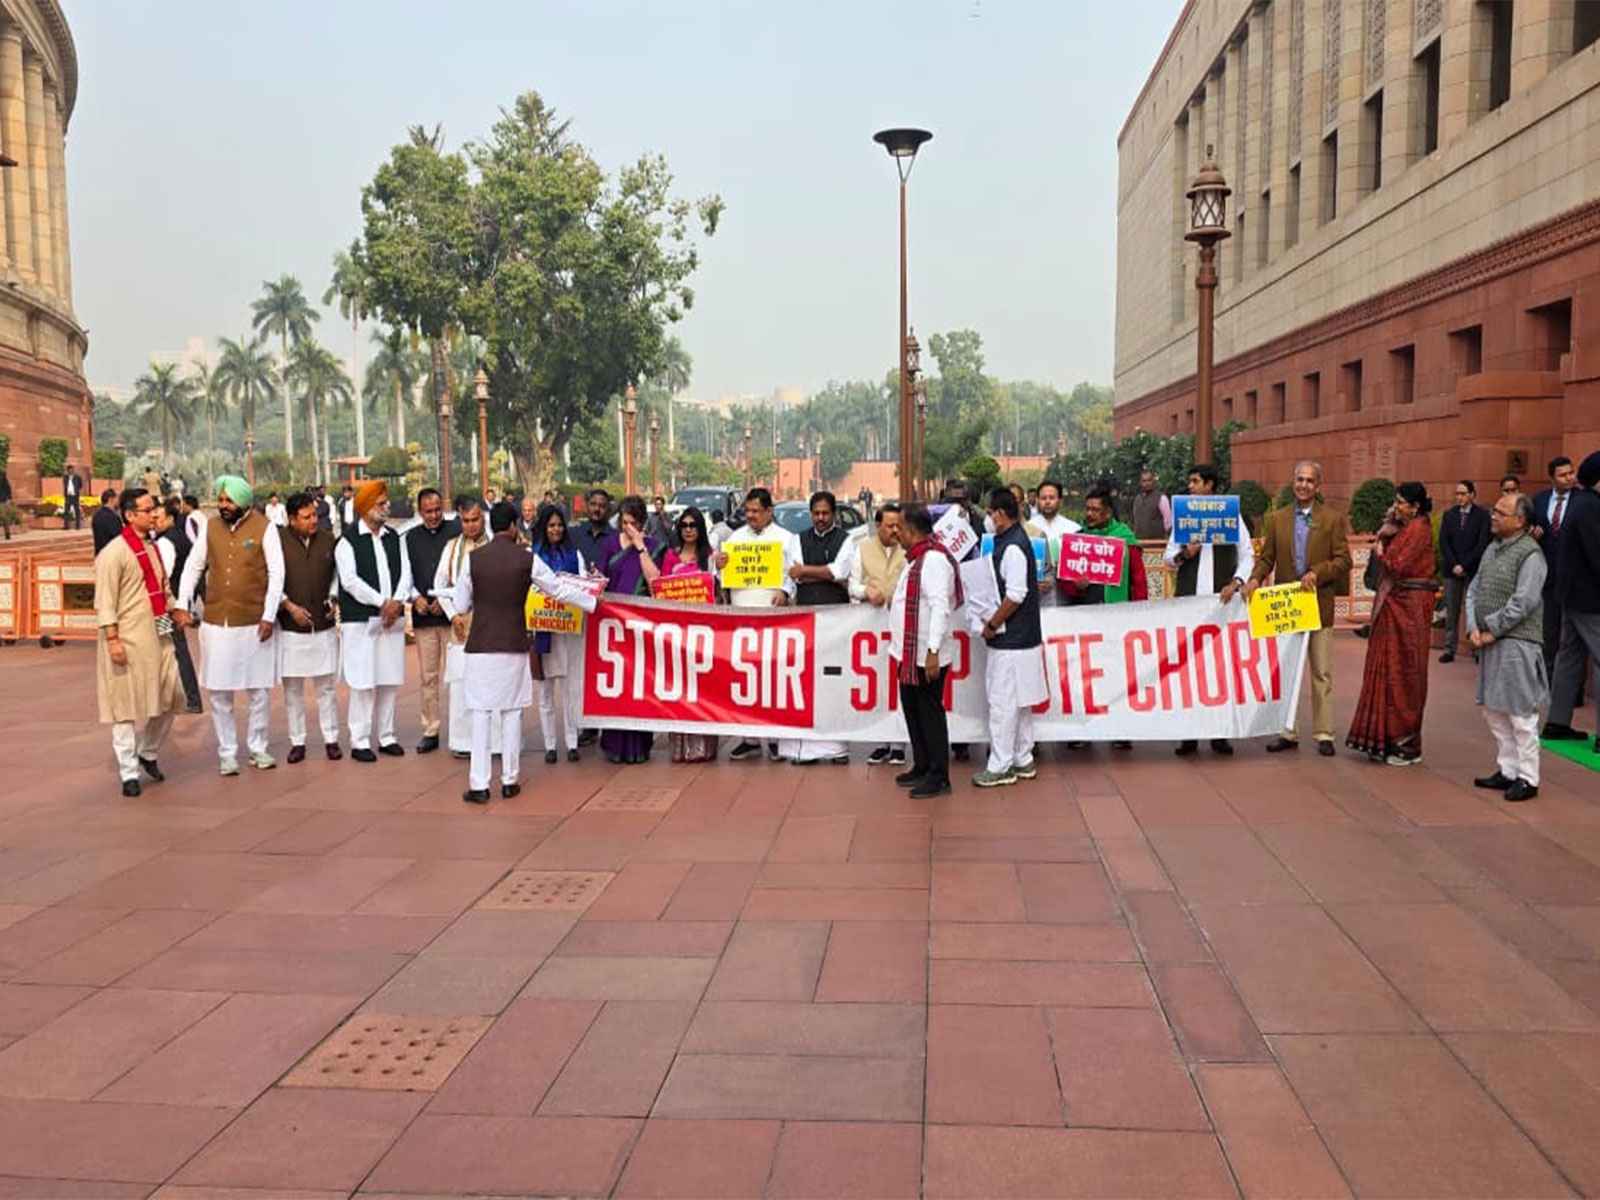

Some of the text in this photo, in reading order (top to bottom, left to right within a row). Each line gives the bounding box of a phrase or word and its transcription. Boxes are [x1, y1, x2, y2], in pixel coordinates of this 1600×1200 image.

[1070, 538, 1115, 557] वोट चोर
[596, 618, 714, 703] STOP
[730, 625, 805, 711] SIR
[850, 630, 971, 712] STP
[1030, 633, 1109, 715] TE
[1123, 620, 1281, 712] CHORI
